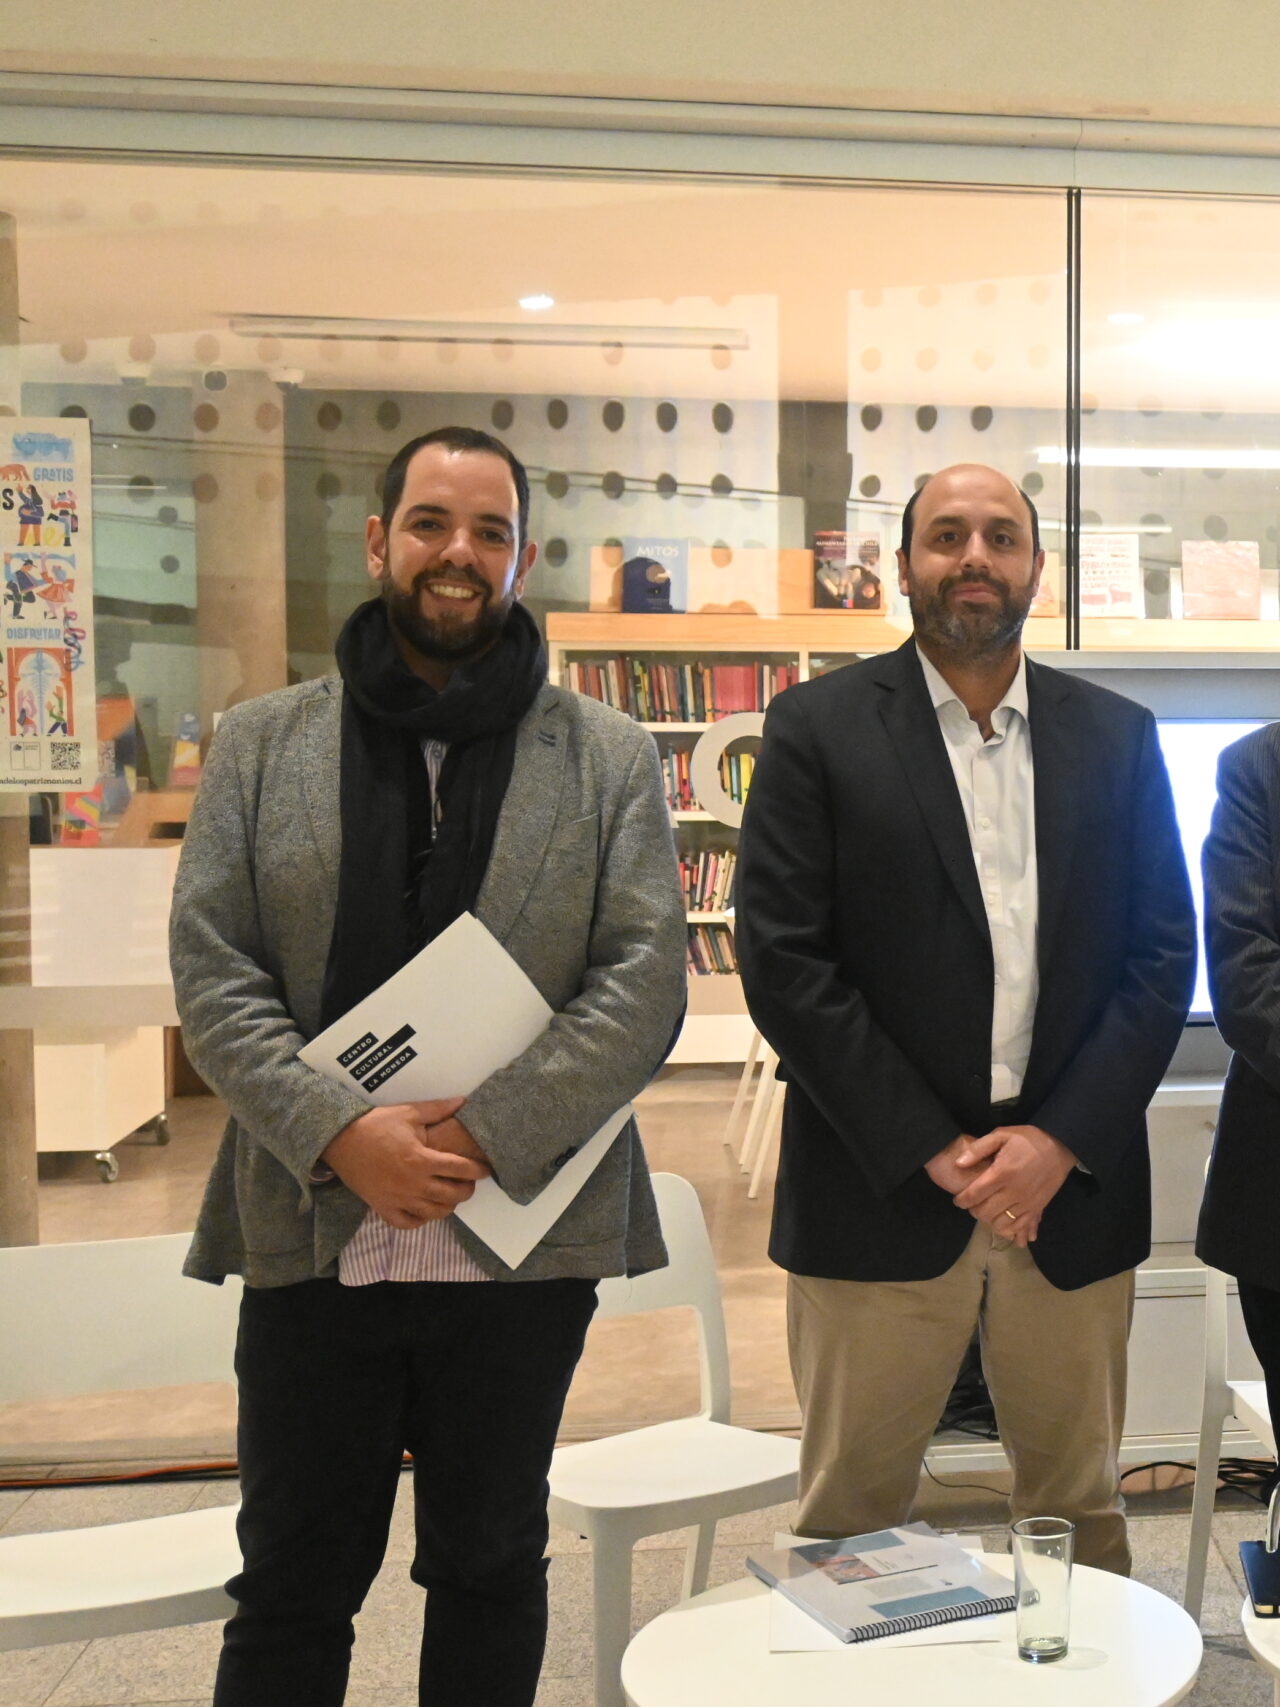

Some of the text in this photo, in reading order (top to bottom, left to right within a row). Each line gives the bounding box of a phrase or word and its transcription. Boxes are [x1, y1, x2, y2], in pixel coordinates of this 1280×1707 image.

[33, 467, 74, 482] GRATIS
[636, 546, 679, 557] MITOS
[7, 627, 61, 640] DISFRUTAR
[342, 1037, 372, 1063] CENTRO
[355, 1044, 393, 1075] CULTURAL
[368, 1051, 412, 1088] LA MONEDA
